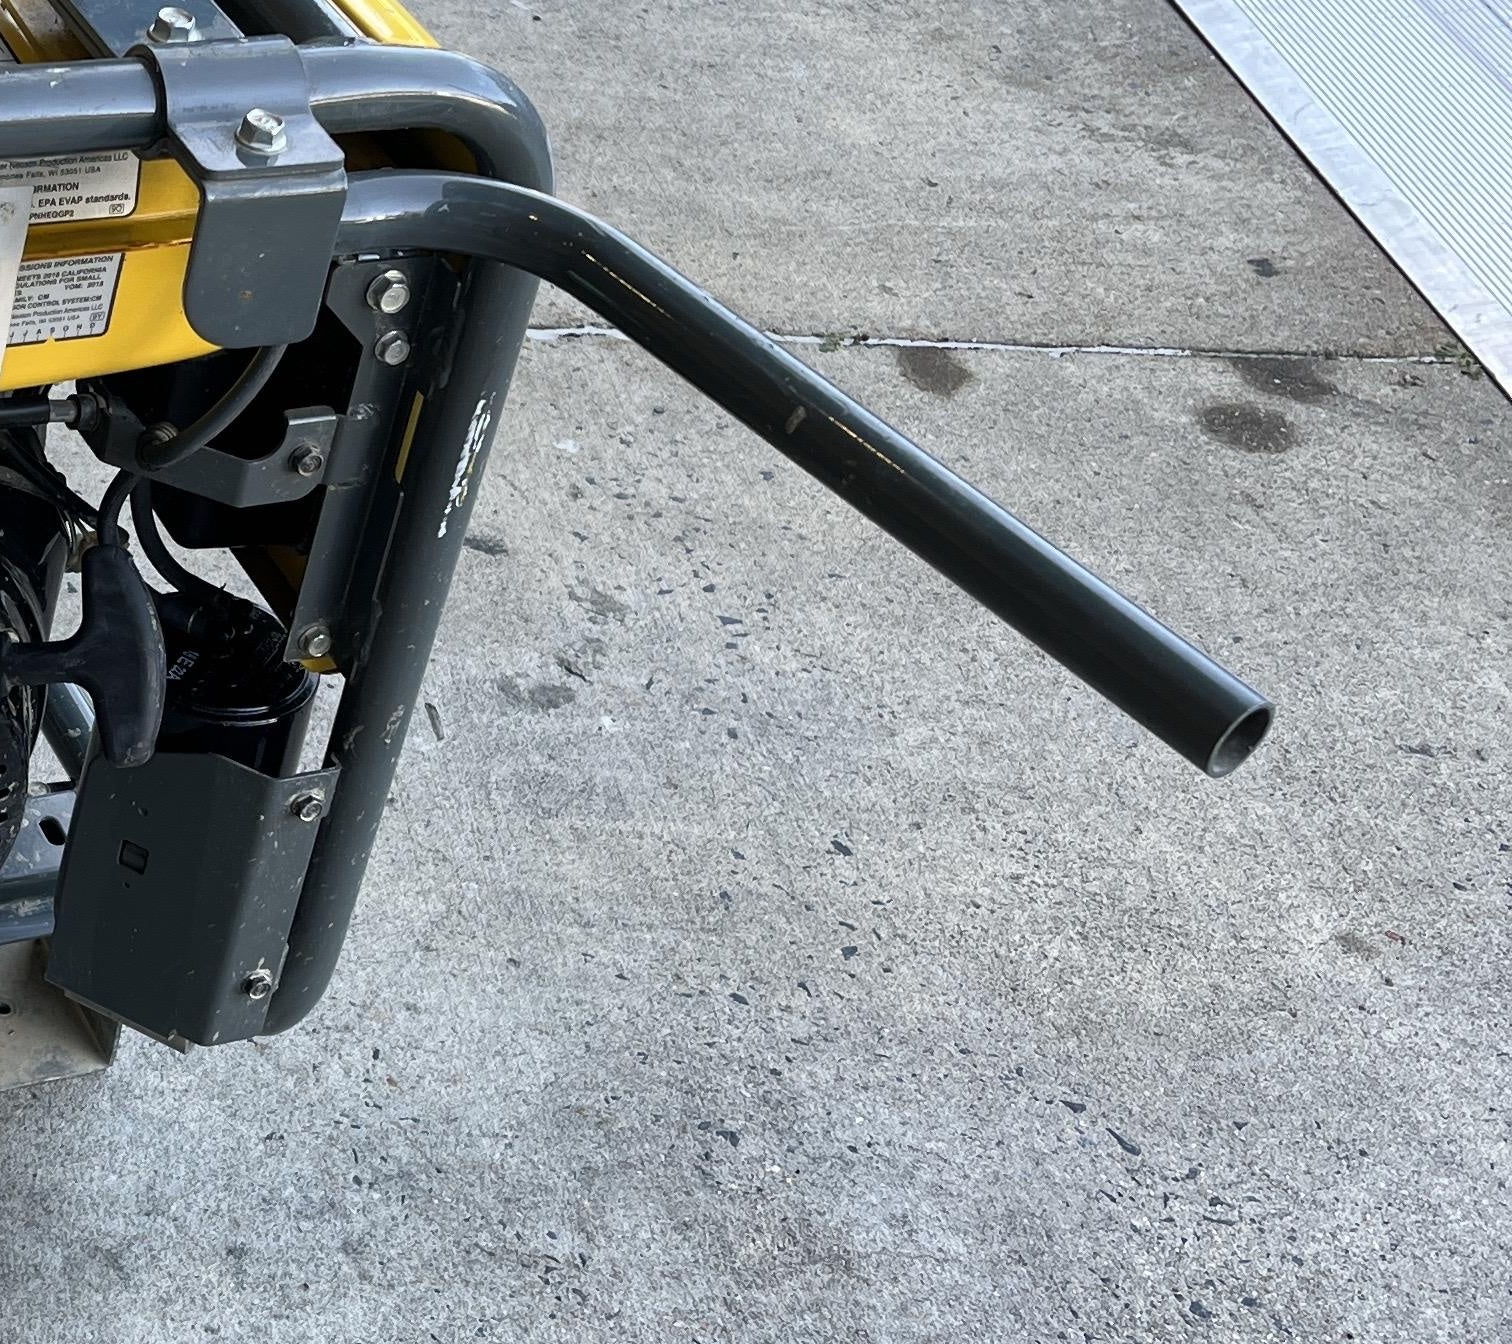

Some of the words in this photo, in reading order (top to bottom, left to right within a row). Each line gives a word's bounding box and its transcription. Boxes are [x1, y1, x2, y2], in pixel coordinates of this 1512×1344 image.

[38, 156, 78, 168] Production
[113, 152, 128, 161] LLC
[85, 166, 101, 175] USA
[33, 182, 80, 193] RMATION
[38, 198, 57, 208] EPA
[58, 195, 83, 206] EVAP
[85, 192, 131, 204] standards.
[19, 262, 53, 272] SSIONS
[53, 255, 114, 268] INFORMATION
[61, 266, 107, 277] CALIFORNIA
[58, 276, 75, 284] FOR
[76, 274, 102, 282] SMALL
[26, 300, 60, 309] CONTROL
[90, 303, 104, 311] LLC
